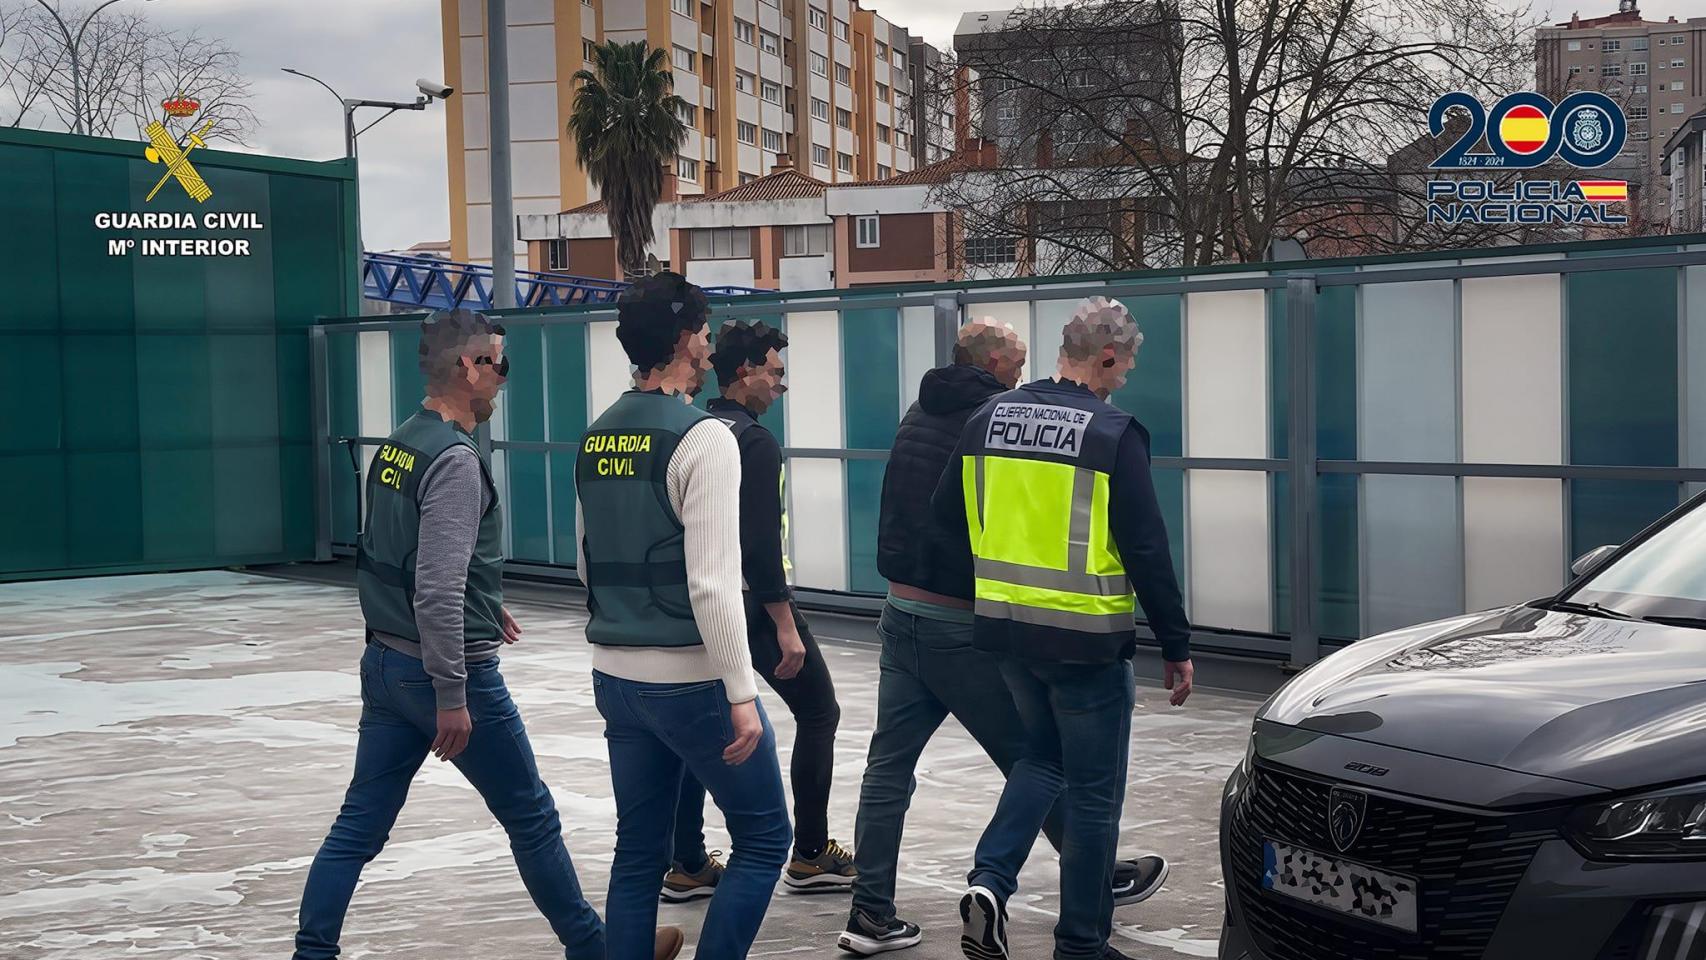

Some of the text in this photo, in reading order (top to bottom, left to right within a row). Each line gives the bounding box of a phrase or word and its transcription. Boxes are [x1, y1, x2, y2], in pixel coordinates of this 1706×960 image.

[995, 407, 1086, 424] CUERPO NACIONAL DE
[584, 435, 651, 453] GUARDIA
[988, 420, 1076, 452] POLICIA
[597, 457, 635, 476] CIVIL
